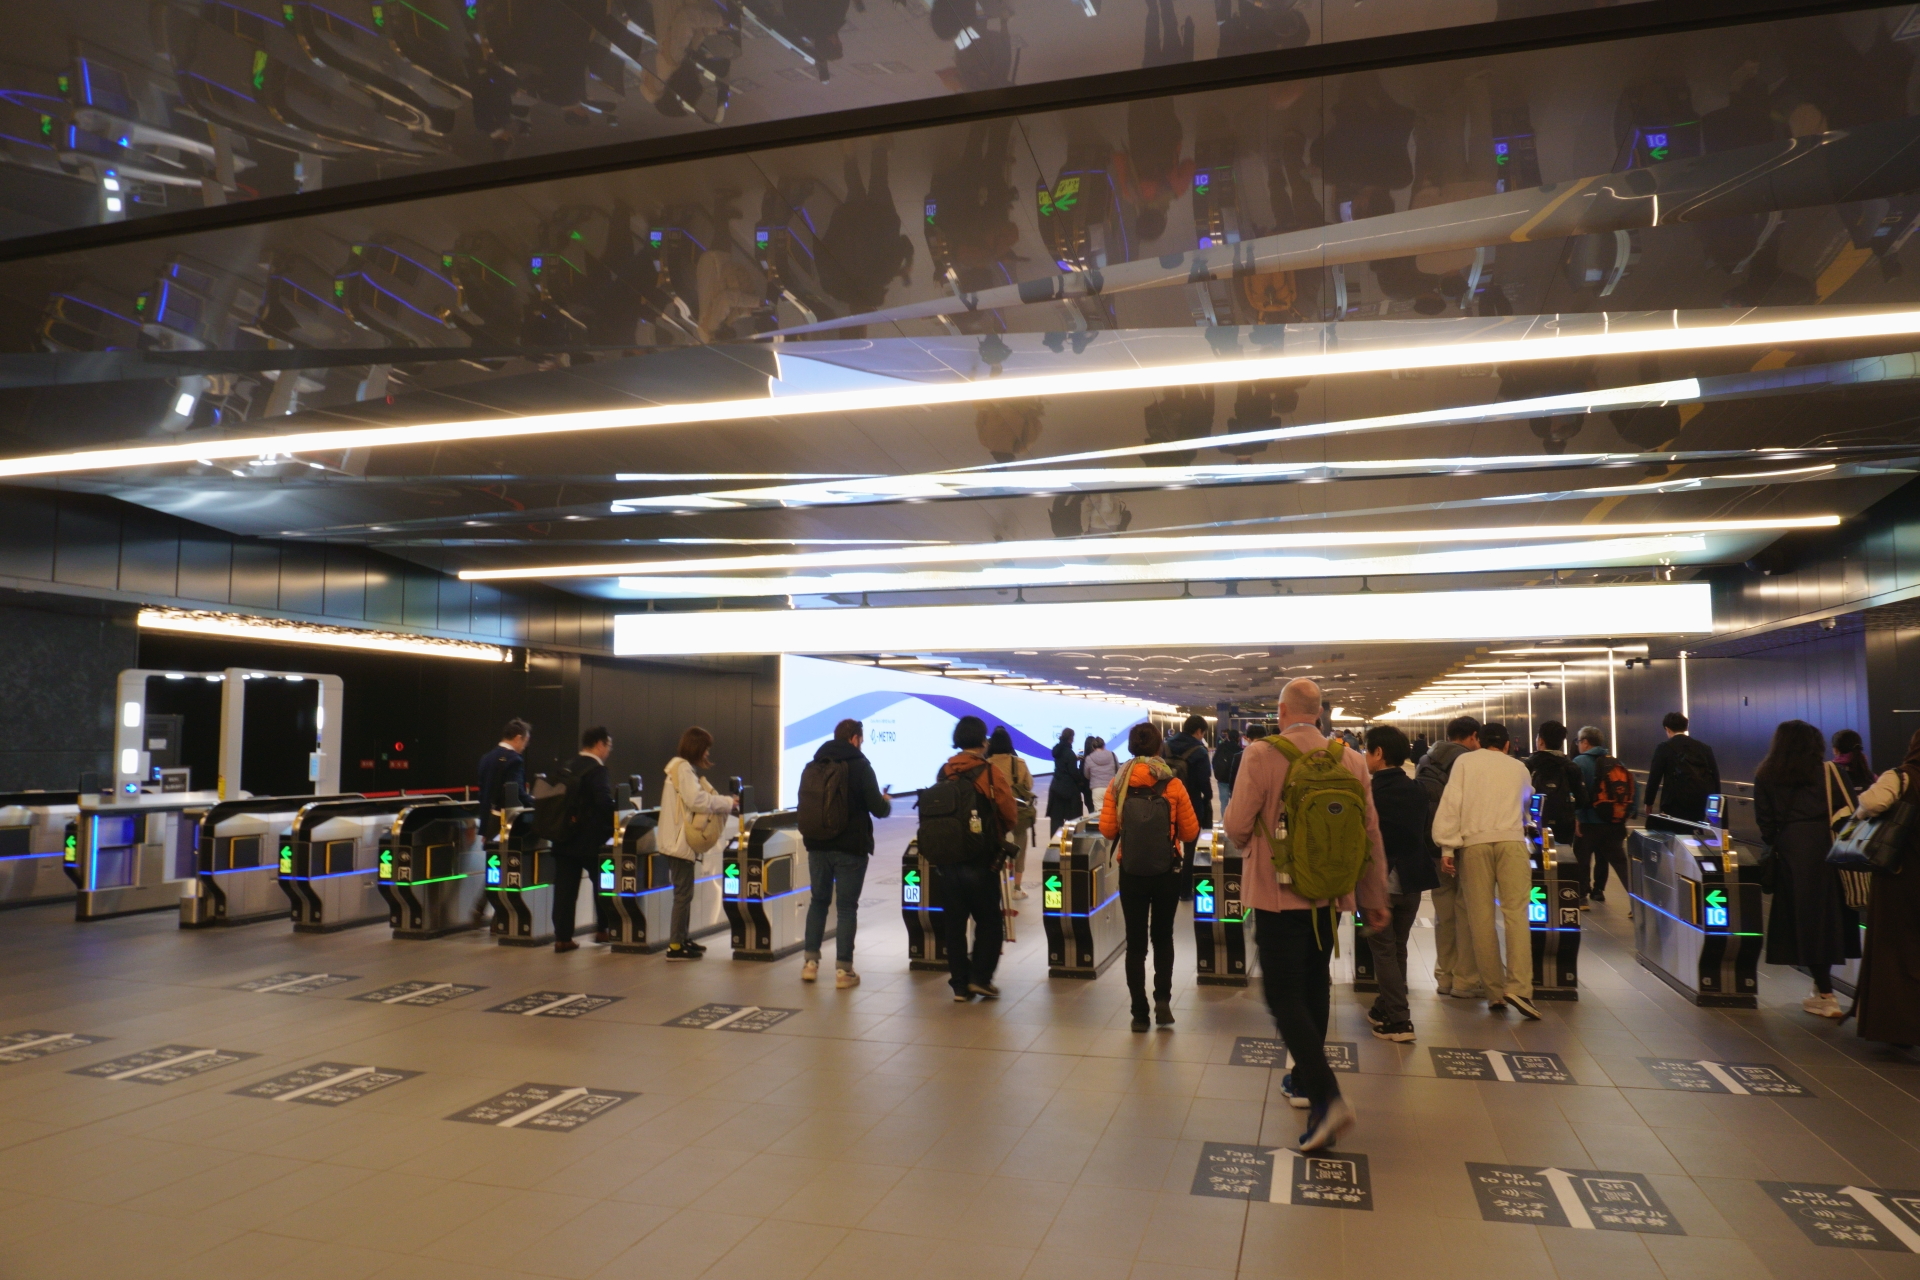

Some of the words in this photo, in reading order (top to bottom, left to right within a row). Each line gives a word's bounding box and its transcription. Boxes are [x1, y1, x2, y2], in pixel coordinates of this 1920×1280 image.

[488, 868, 500, 883] IC
[905, 887, 918, 900] QR
[1197, 897, 1213, 912] IC
[1528, 905, 1546, 920] IC
[1707, 908, 1727, 925] IC
[1224, 1149, 1254, 1159] Tap
[1208, 1155, 1227, 1163] to
[1231, 1155, 1266, 1165] ride
[1318, 1161, 1343, 1170] QR
[1490, 1170, 1525, 1180] Tap
[1209, 1176, 1260, 1186] タッチ
[1479, 1176, 1500, 1185] to
[1504, 1177, 1543, 1187] ride
[1598, 1181, 1627, 1191] QR
[1213, 1183, 1251, 1194] 決済
[1296, 1183, 1367, 1196] デジタル
[1789, 1189, 1828, 1199] Tap
[1493, 1199, 1549, 1210] タッチ
[1781, 1196, 1806, 1204] to
[1810, 1198, 1853, 1208] ride
[1590, 1205, 1669, 1219] デジタル
[1812, 1222, 1875, 1233] タッチ
